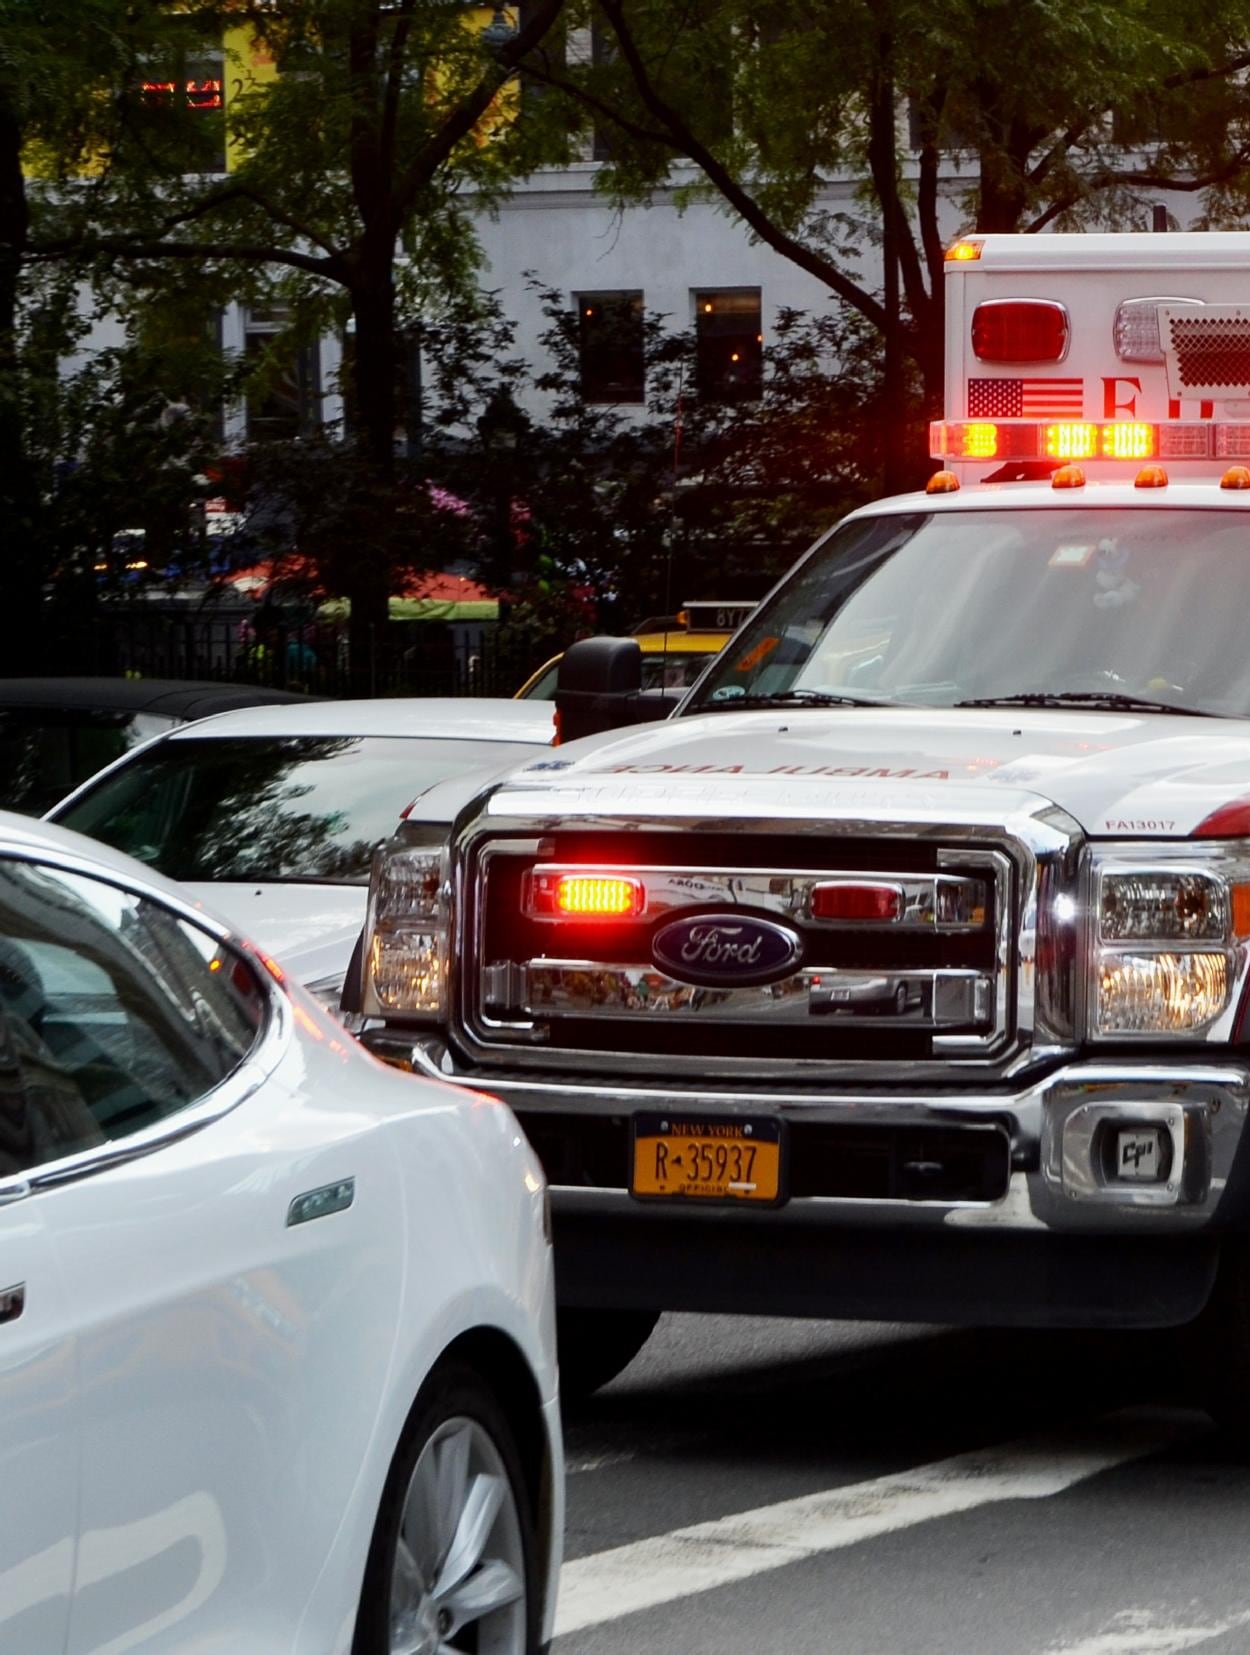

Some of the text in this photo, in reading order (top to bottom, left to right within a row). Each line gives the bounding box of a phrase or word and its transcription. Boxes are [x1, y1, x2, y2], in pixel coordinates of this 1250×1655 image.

[1105, 820, 1176, 831] FA13017
[681, 925, 763, 964] Ford
[671, 1122, 743, 1138] NEW YORK
